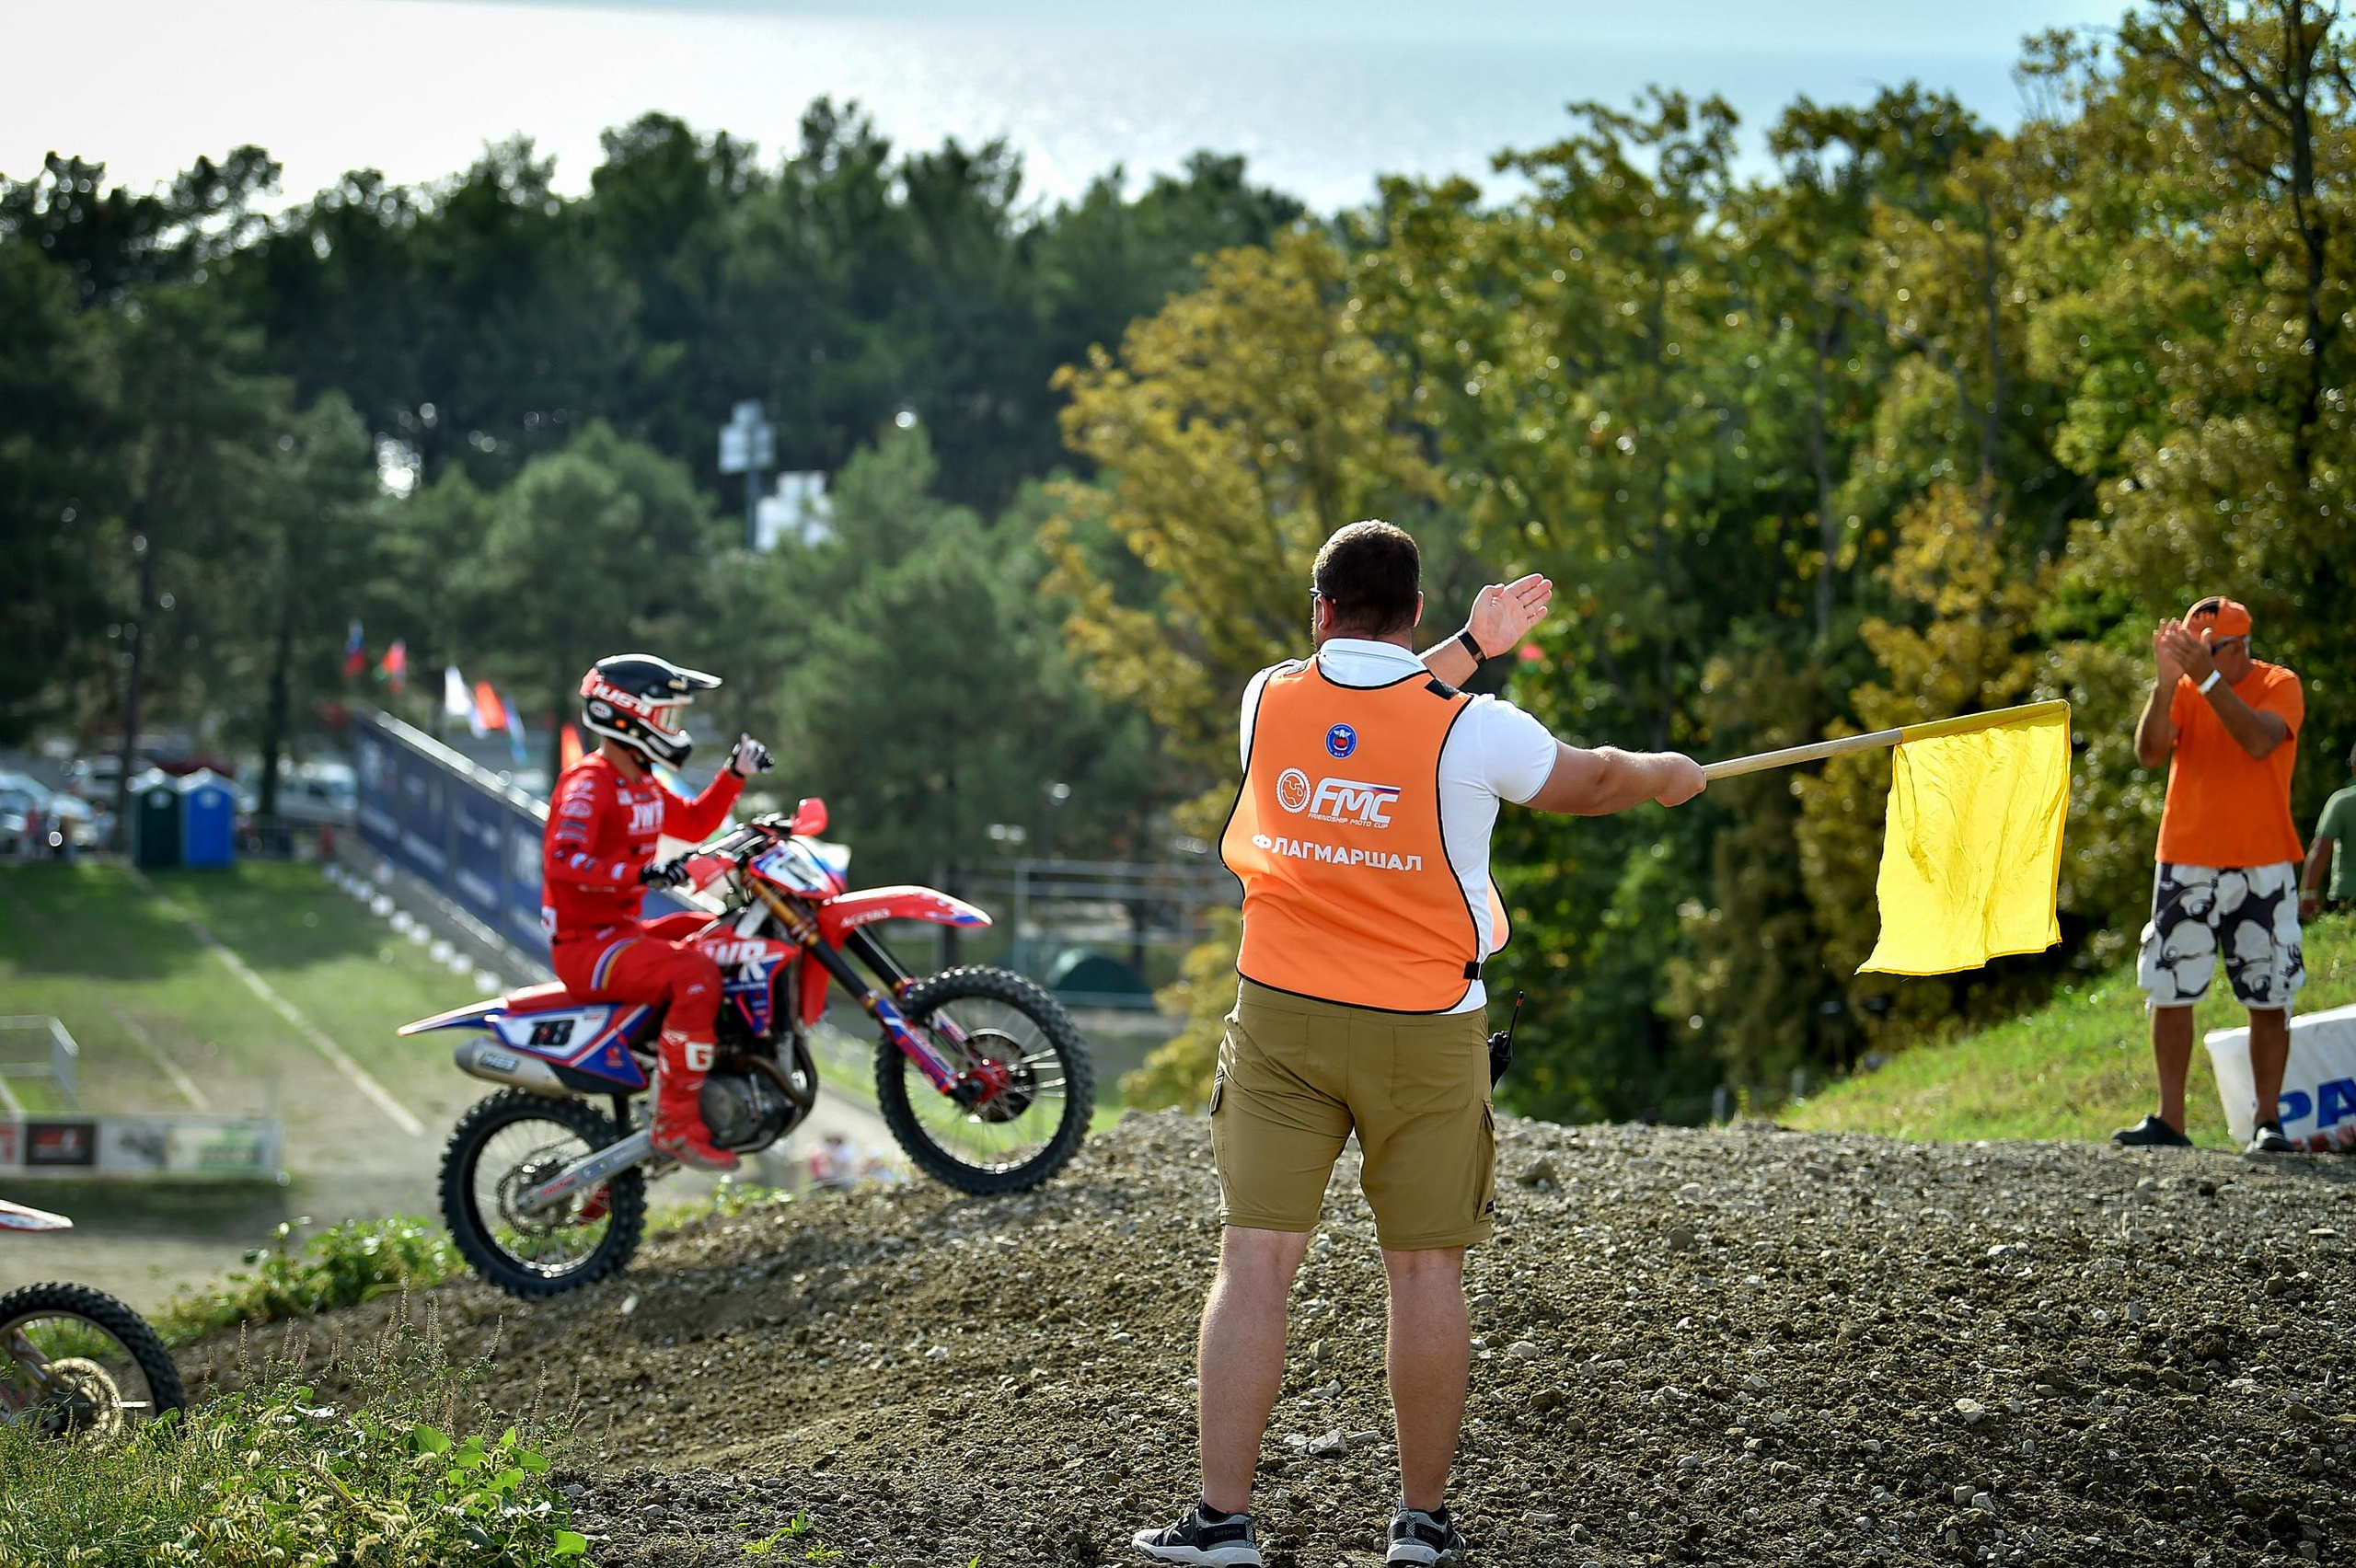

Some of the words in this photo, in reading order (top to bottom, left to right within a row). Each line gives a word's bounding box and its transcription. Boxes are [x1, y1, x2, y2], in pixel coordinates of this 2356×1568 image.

[1310, 778, 1401, 824] FMC
[1308, 813, 1348, 824] FRIENDSHIP
[1349, 818, 1372, 827] MOTO
[1252, 834, 1422, 871] ФЛАГМАРШАЛ
